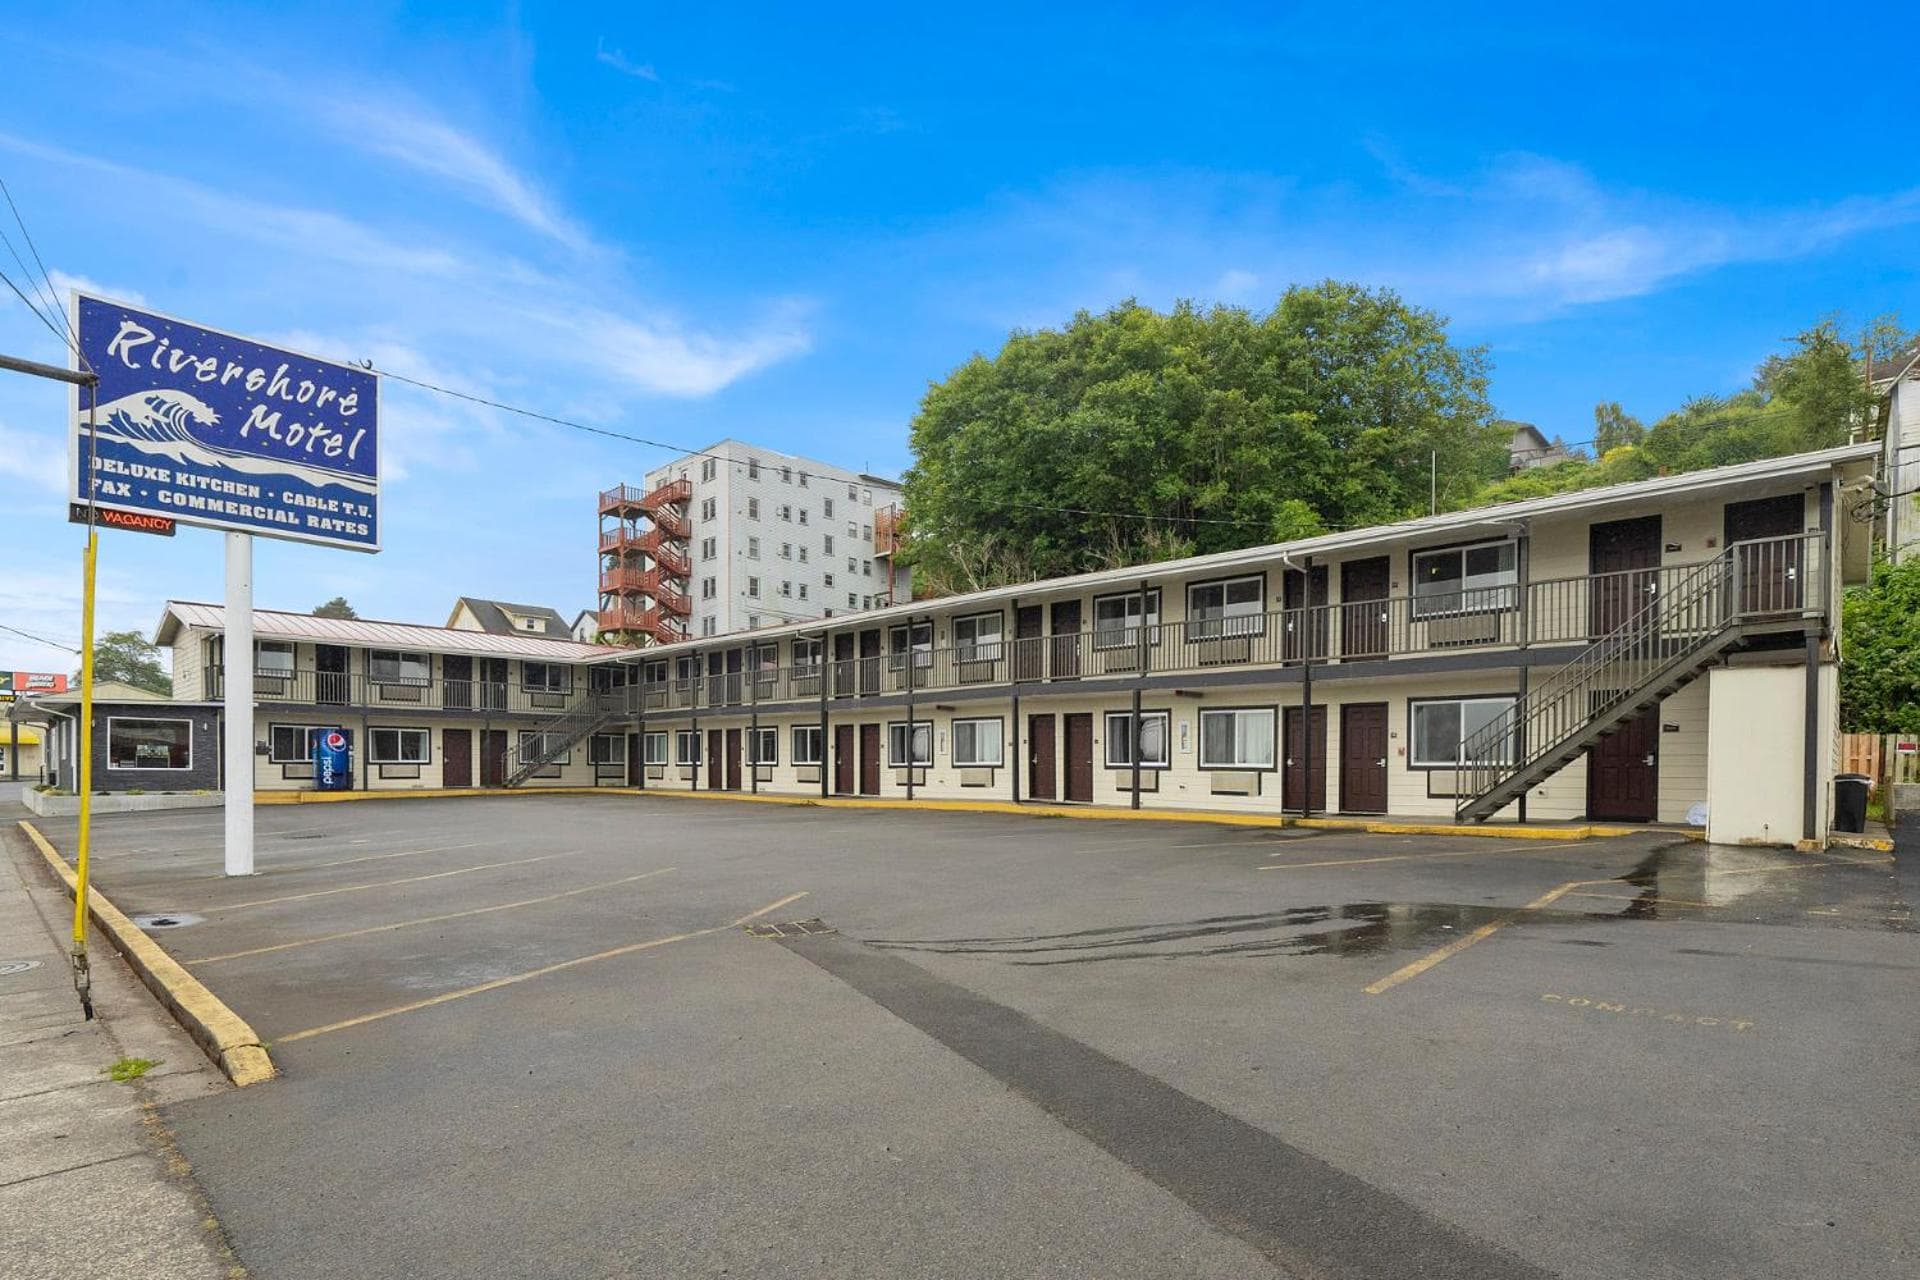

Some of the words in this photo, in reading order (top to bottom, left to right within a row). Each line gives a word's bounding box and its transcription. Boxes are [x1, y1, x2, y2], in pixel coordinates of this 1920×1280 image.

[107, 320, 359, 416] Rivershore
[240, 404, 366, 459] Motel
[88, 456, 170, 482] DELUXE
[175, 472, 260, 498] KITCHEN
[282, 491, 339, 512] CABLE
[342, 501, 372, 518] T.V.
[158, 489, 299, 524] COMMERCIAL
[306, 515, 369, 535] RATES
[102, 511, 172, 530] VACANCY
[323, 756, 334, 784] pepsi
